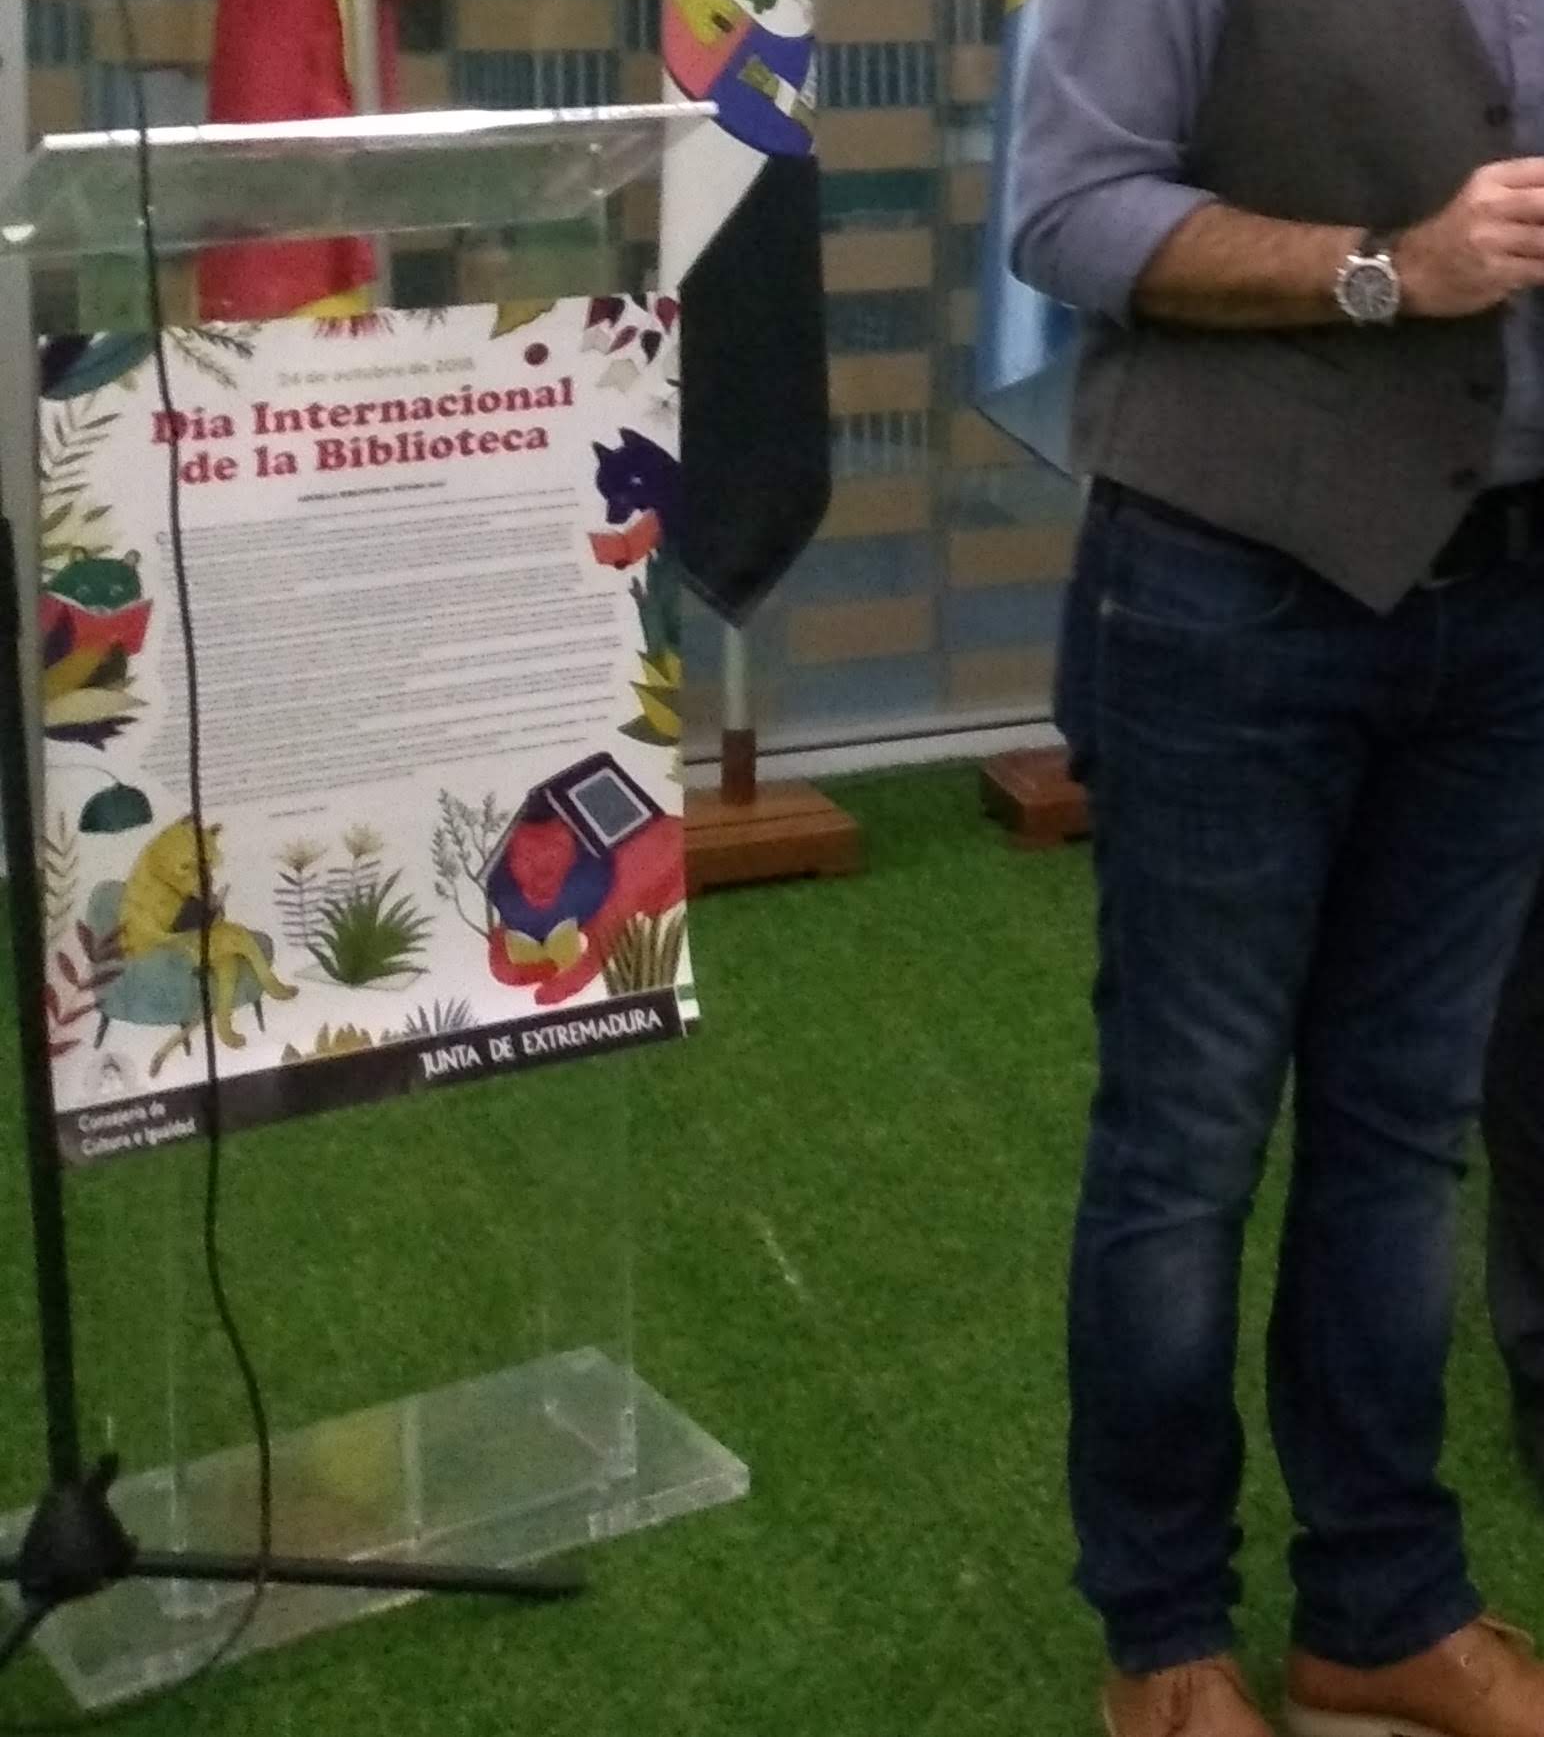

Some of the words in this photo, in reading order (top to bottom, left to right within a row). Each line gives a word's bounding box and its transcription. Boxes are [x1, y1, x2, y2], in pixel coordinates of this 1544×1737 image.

[251, 375, 574, 435] Internacional
[180, 449, 238, 484] de
[254, 445, 297, 477] la
[315, 426, 548, 470] Biblioteca
[419, 1044, 482, 1080] JUNTA
[489, 1034, 515, 1062] DE
[522, 1008, 664, 1056] EXTREMADURA
